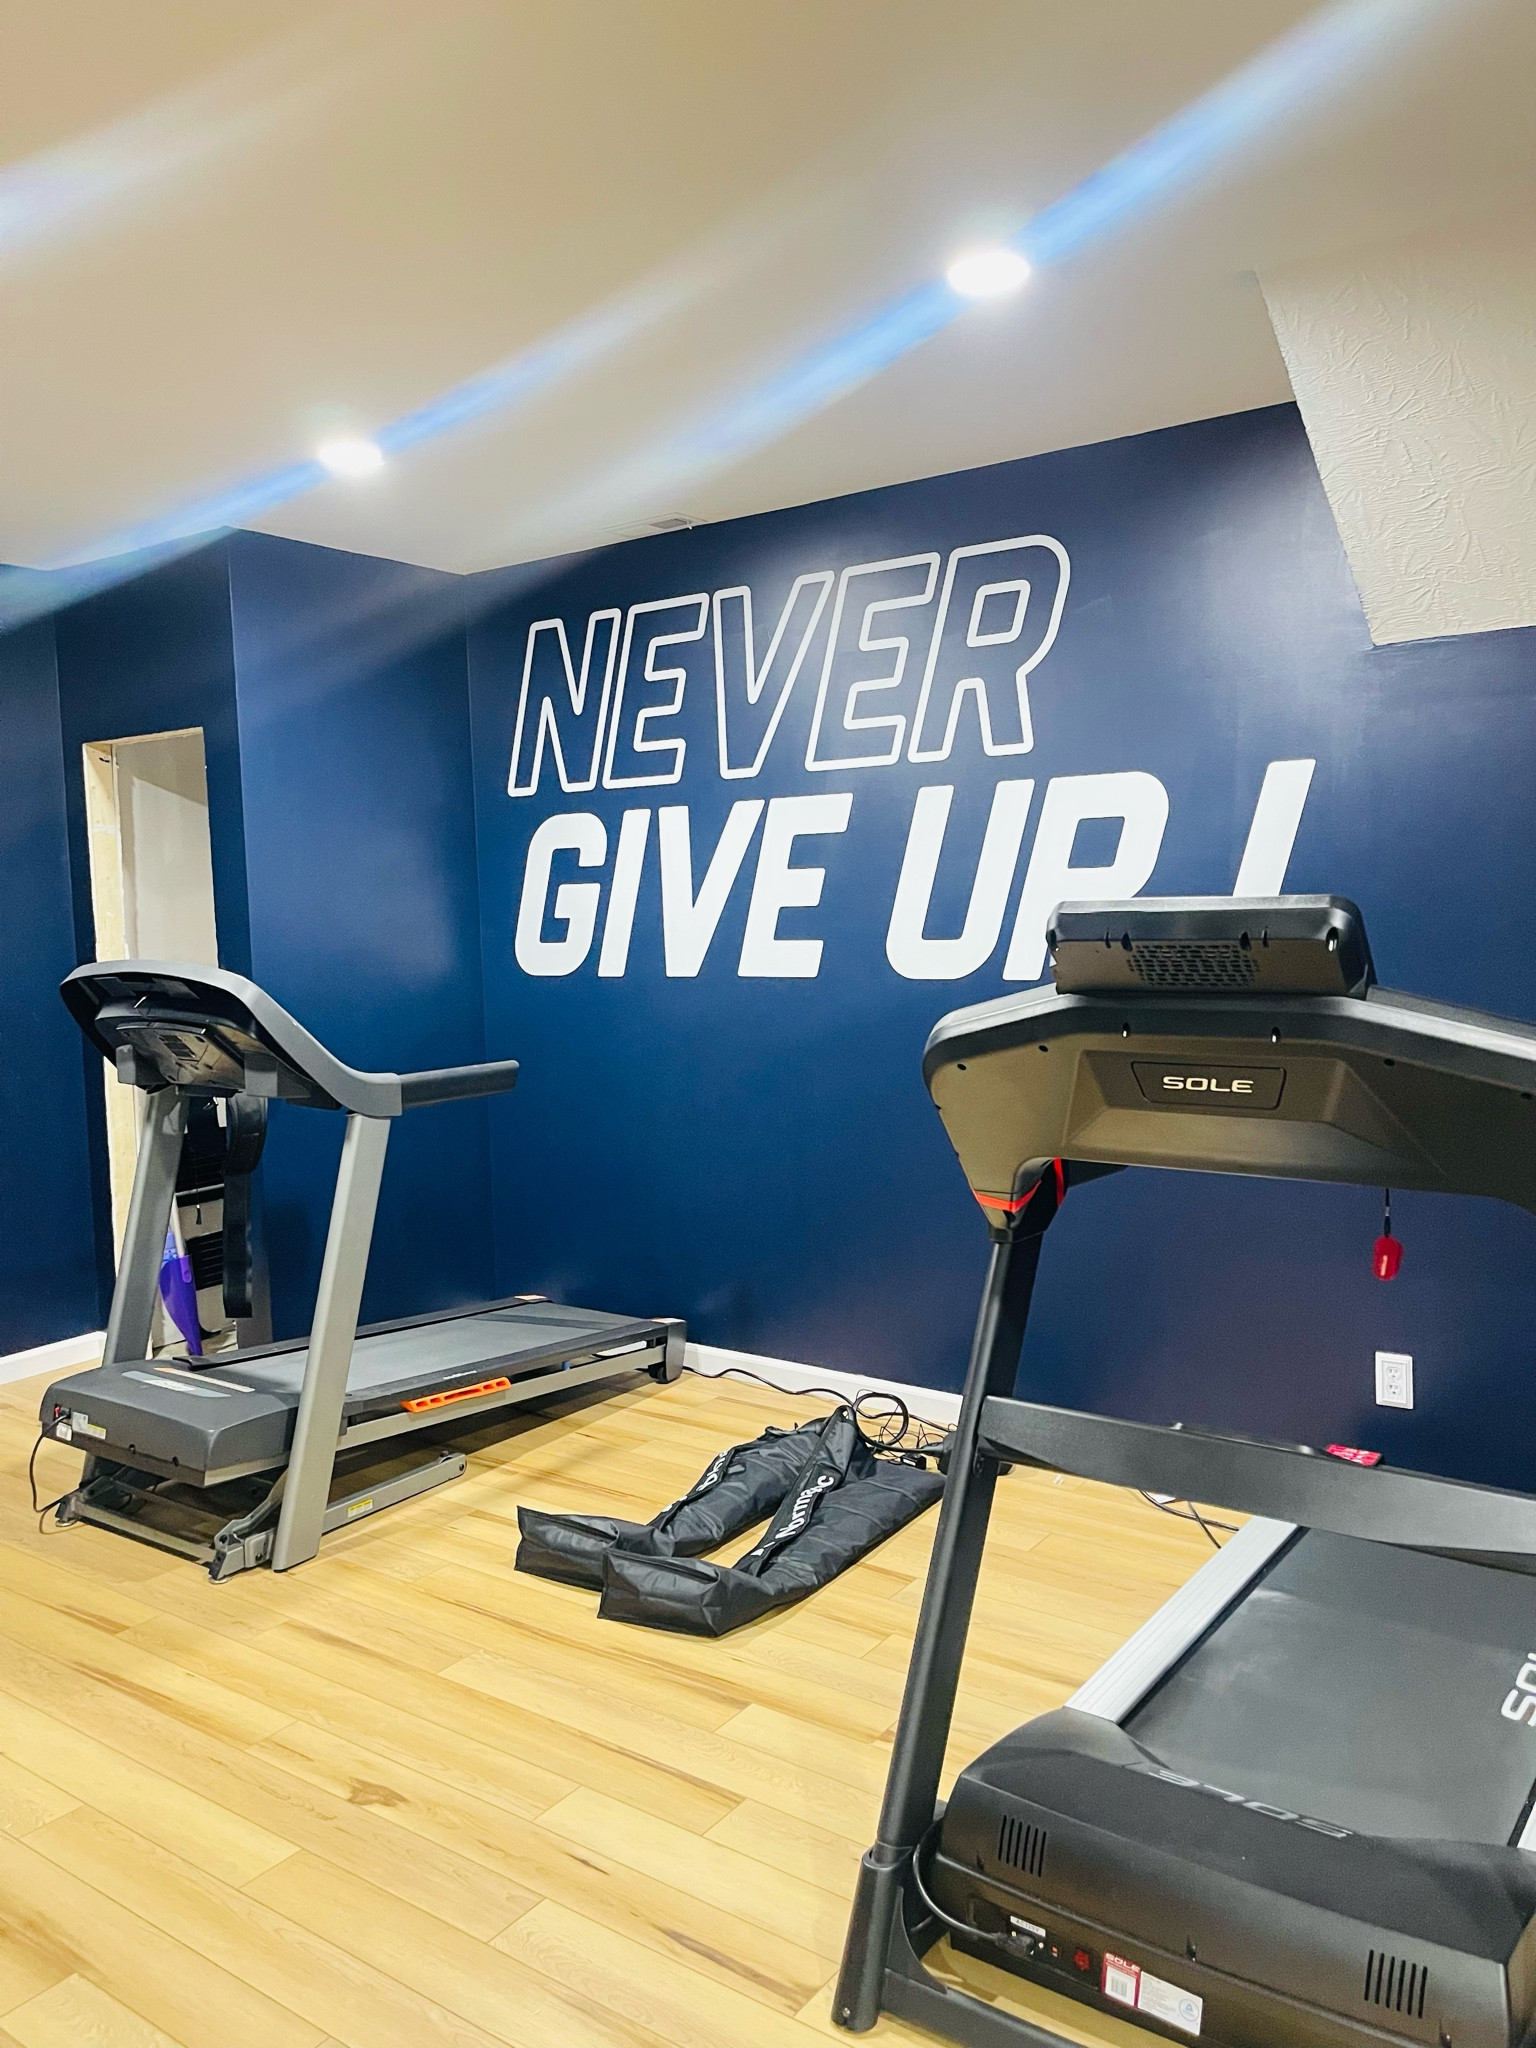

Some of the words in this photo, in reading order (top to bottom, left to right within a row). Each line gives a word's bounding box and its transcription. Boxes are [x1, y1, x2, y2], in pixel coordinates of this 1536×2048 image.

[507, 534, 1071, 798] NEVER
[514, 792, 854, 979] GIVE
[885, 770, 1171, 982] UP
[1162, 1076, 1254, 1094] SOLE
[1147, 1769, 1354, 1839] SOLE
[1105, 1952, 1141, 1973] SOLE
